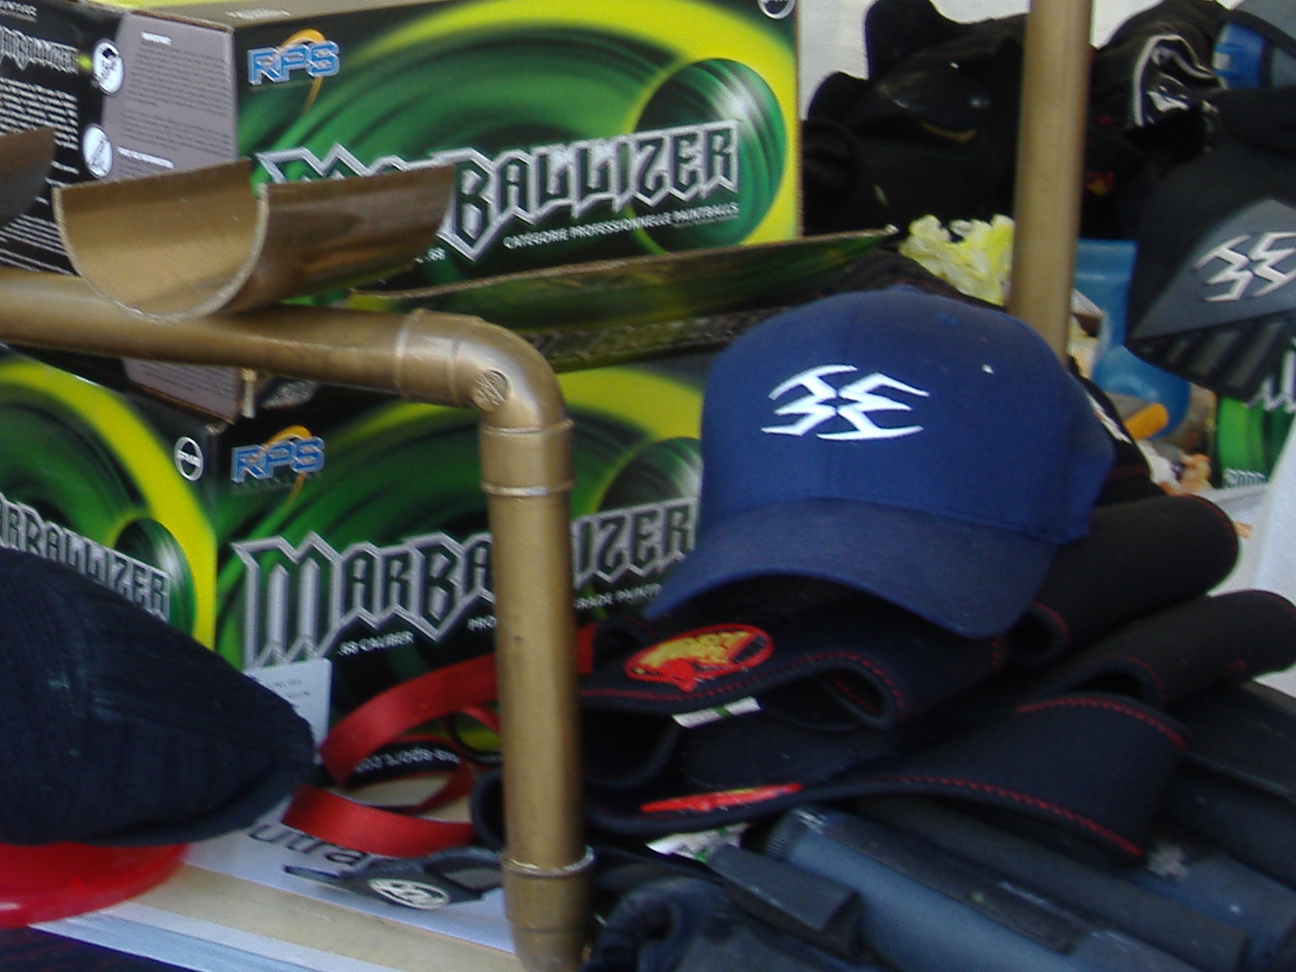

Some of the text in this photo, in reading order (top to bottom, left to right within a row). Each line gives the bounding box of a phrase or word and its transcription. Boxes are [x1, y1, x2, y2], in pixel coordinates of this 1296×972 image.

[247, 39, 340, 86] RPS
[256, 119, 740, 261] BALLIZER
[230, 436, 326, 483] RPS
[358, 630, 415, 652] CALIBER
